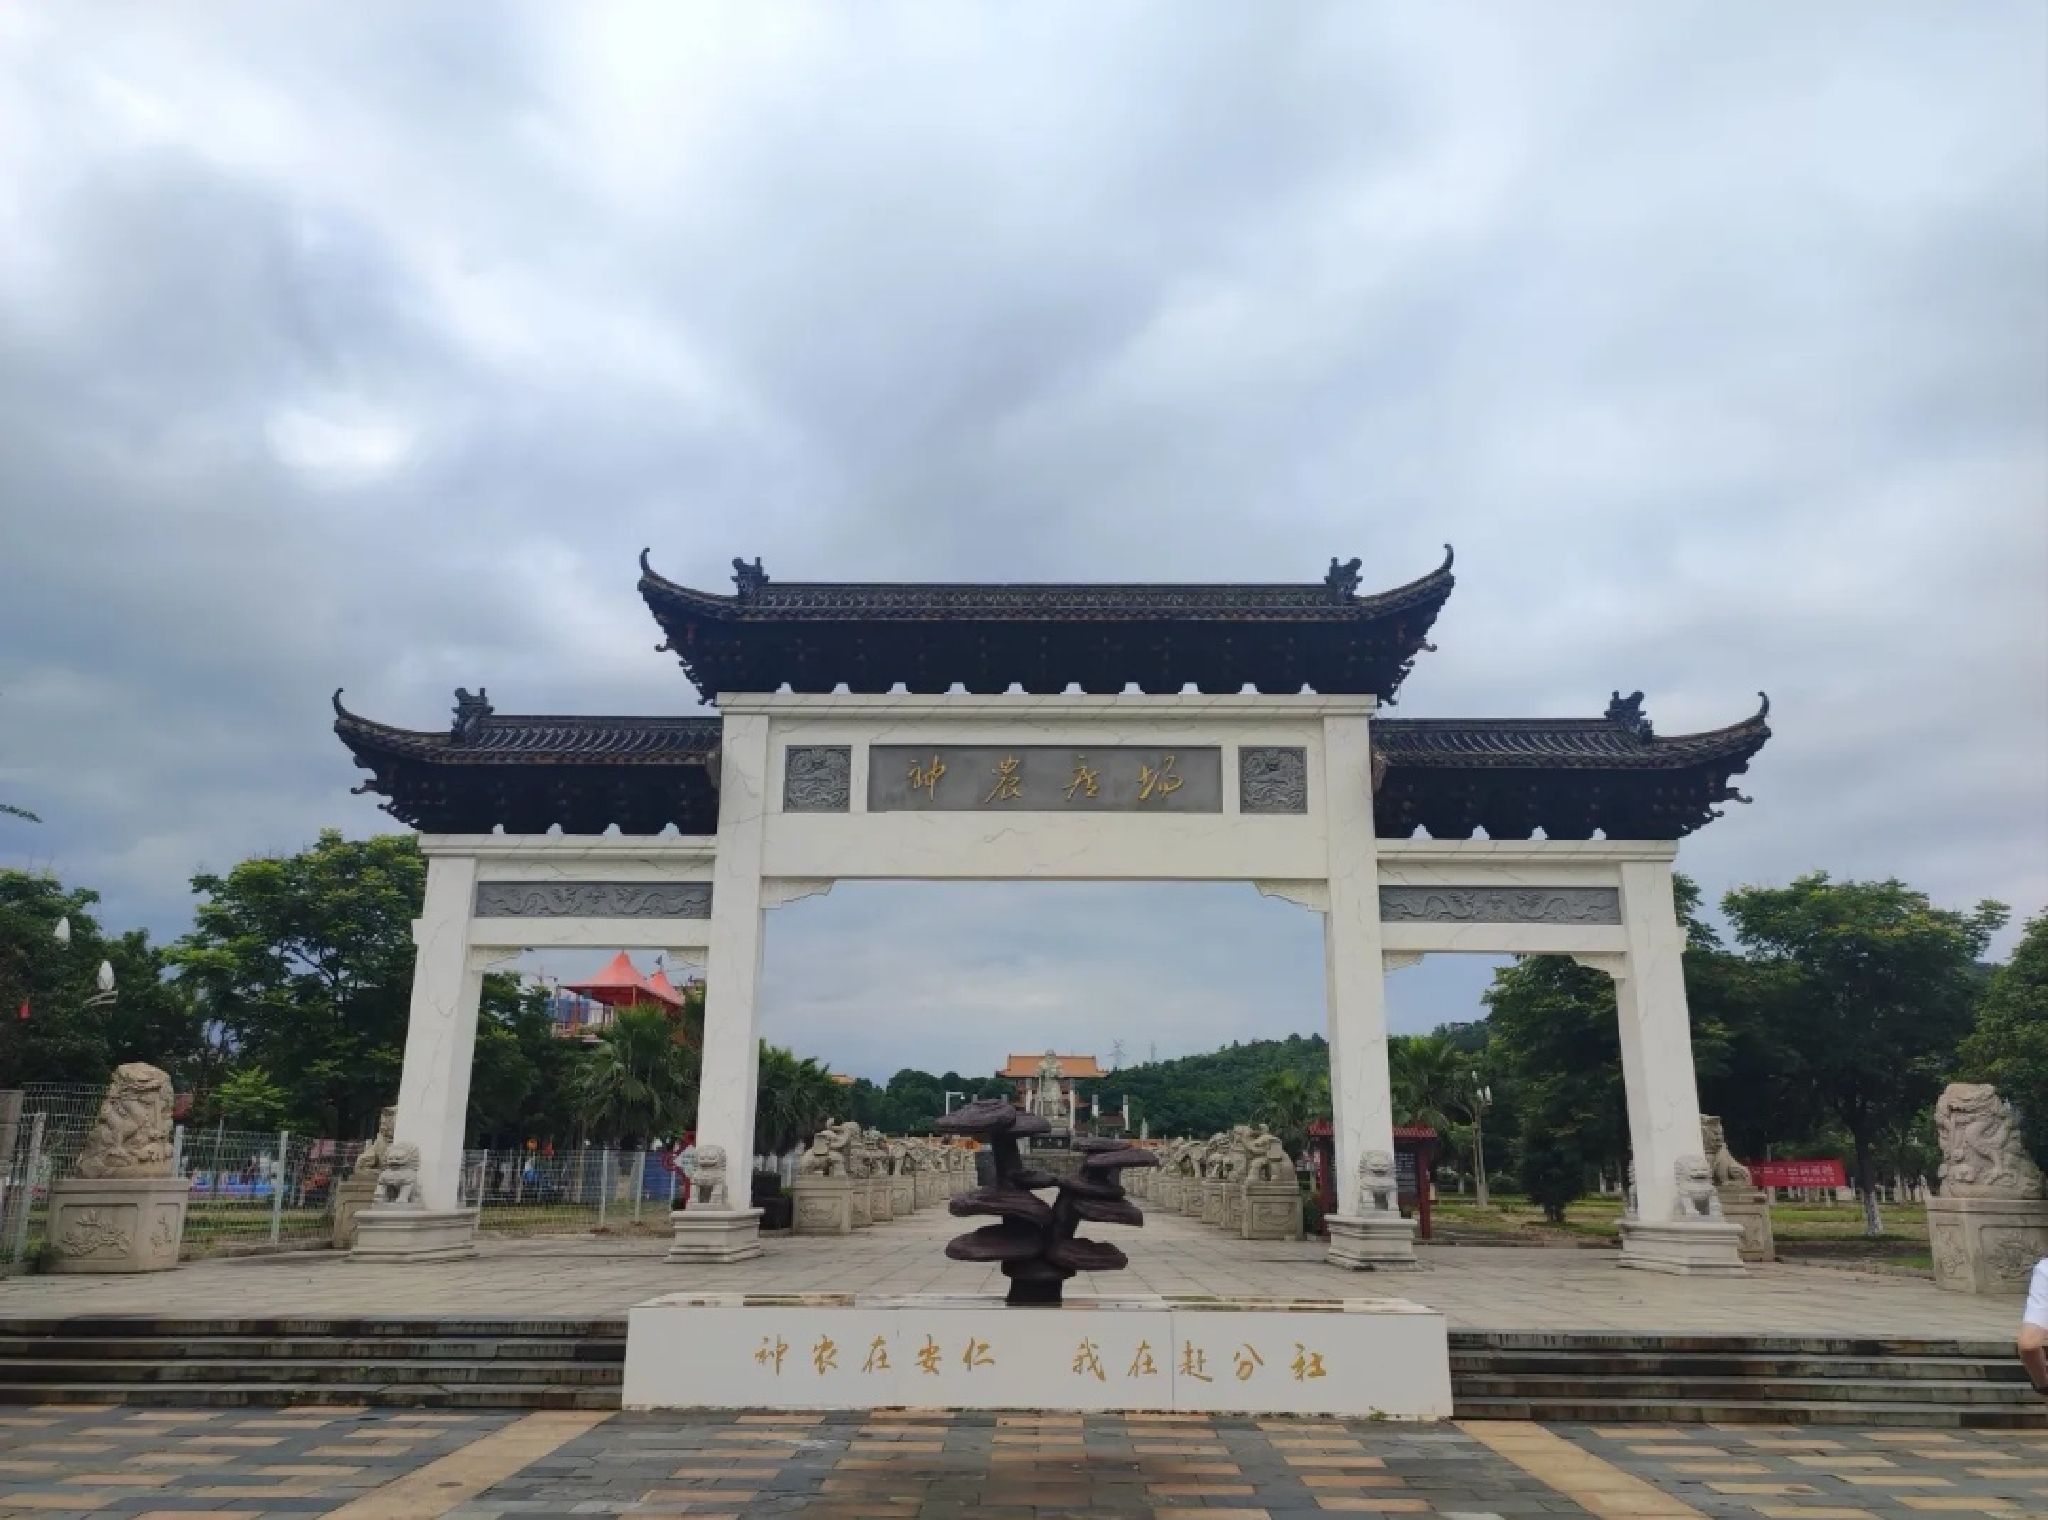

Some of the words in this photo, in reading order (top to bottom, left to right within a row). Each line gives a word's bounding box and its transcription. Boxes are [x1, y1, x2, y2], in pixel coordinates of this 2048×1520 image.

[754, 1333, 995, 1376] 神农在安仁
